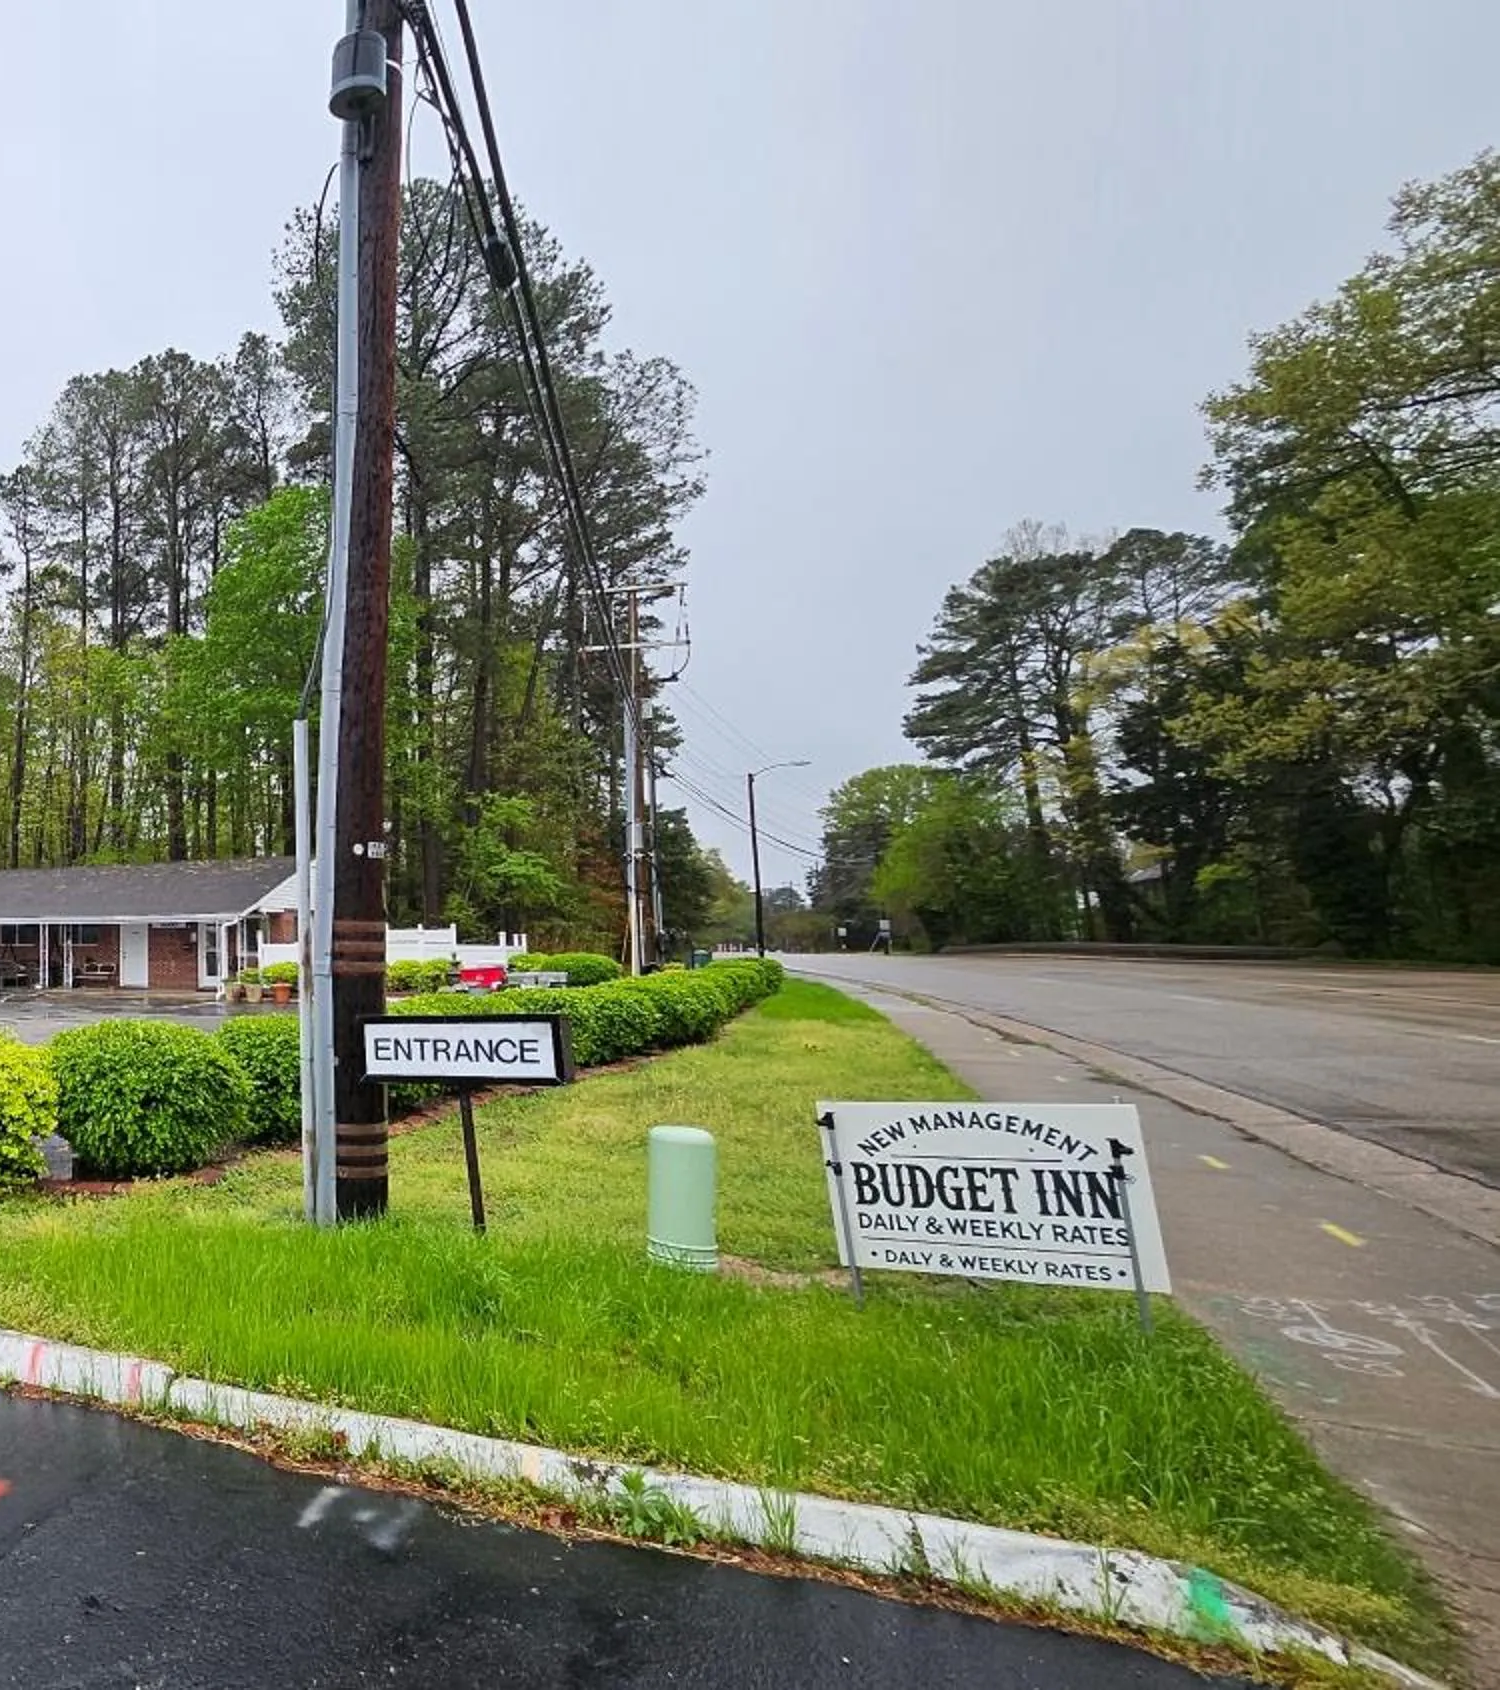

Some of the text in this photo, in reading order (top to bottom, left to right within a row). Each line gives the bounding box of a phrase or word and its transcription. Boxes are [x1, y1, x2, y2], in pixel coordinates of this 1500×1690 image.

[373, 1037, 541, 1065] ENTRANCE
[856, 1111, 1099, 1161] NEW MANAGEMENT
[850, 1161, 1124, 1220] BUDGET INN
[858, 1212, 1130, 1247] DAILY & WEEKLY RATES
[885, 1249, 1112, 1281] DALY & WEEKLY RATES
